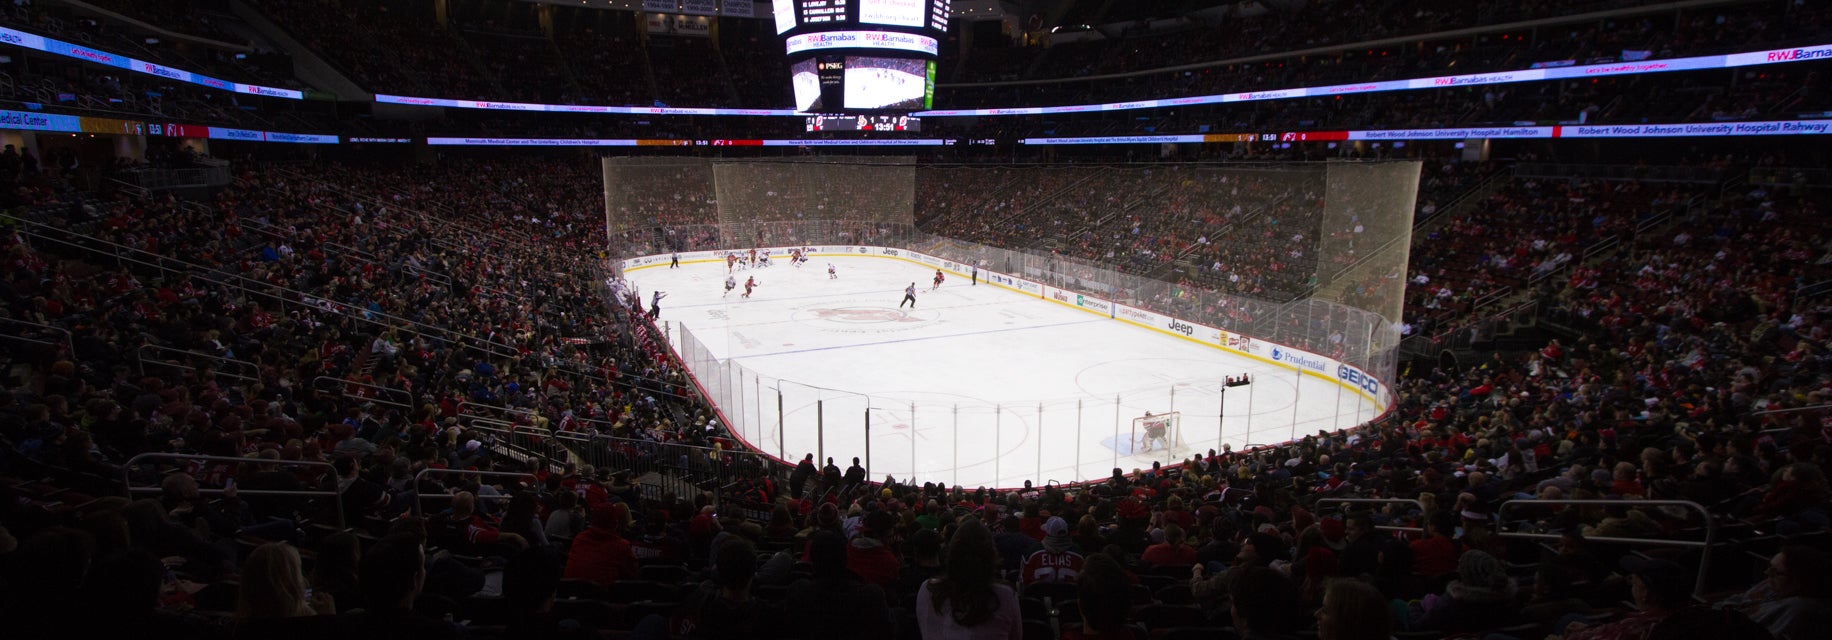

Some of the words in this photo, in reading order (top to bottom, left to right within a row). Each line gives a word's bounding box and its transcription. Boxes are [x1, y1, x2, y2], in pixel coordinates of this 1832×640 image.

[808, 33, 856, 43] RWJBarnabas
[1435, 76, 1487, 85] RWJBarnabas
[0, 112, 22, 125] edical
[24, 114, 48, 126] Center
[1470, 129, 1502, 137] Hospital
[1578, 127, 1610, 135] Robert
[1643, 126, 1683, 134] Johnson
[1686, 124, 1734, 134] University
[1736, 123, 1780, 133] Hospital
[1783, 122, 1829, 132] Rahway
[883, 248, 898, 256] Jeep
[1078, 297, 1108, 310] enterprise
[1168, 319, 1193, 336] Jeep
[1285, 352, 1325, 372] Prudential
[1338, 364, 1378, 395] GEICO
[1042, 553, 1072, 567] ELIAS
